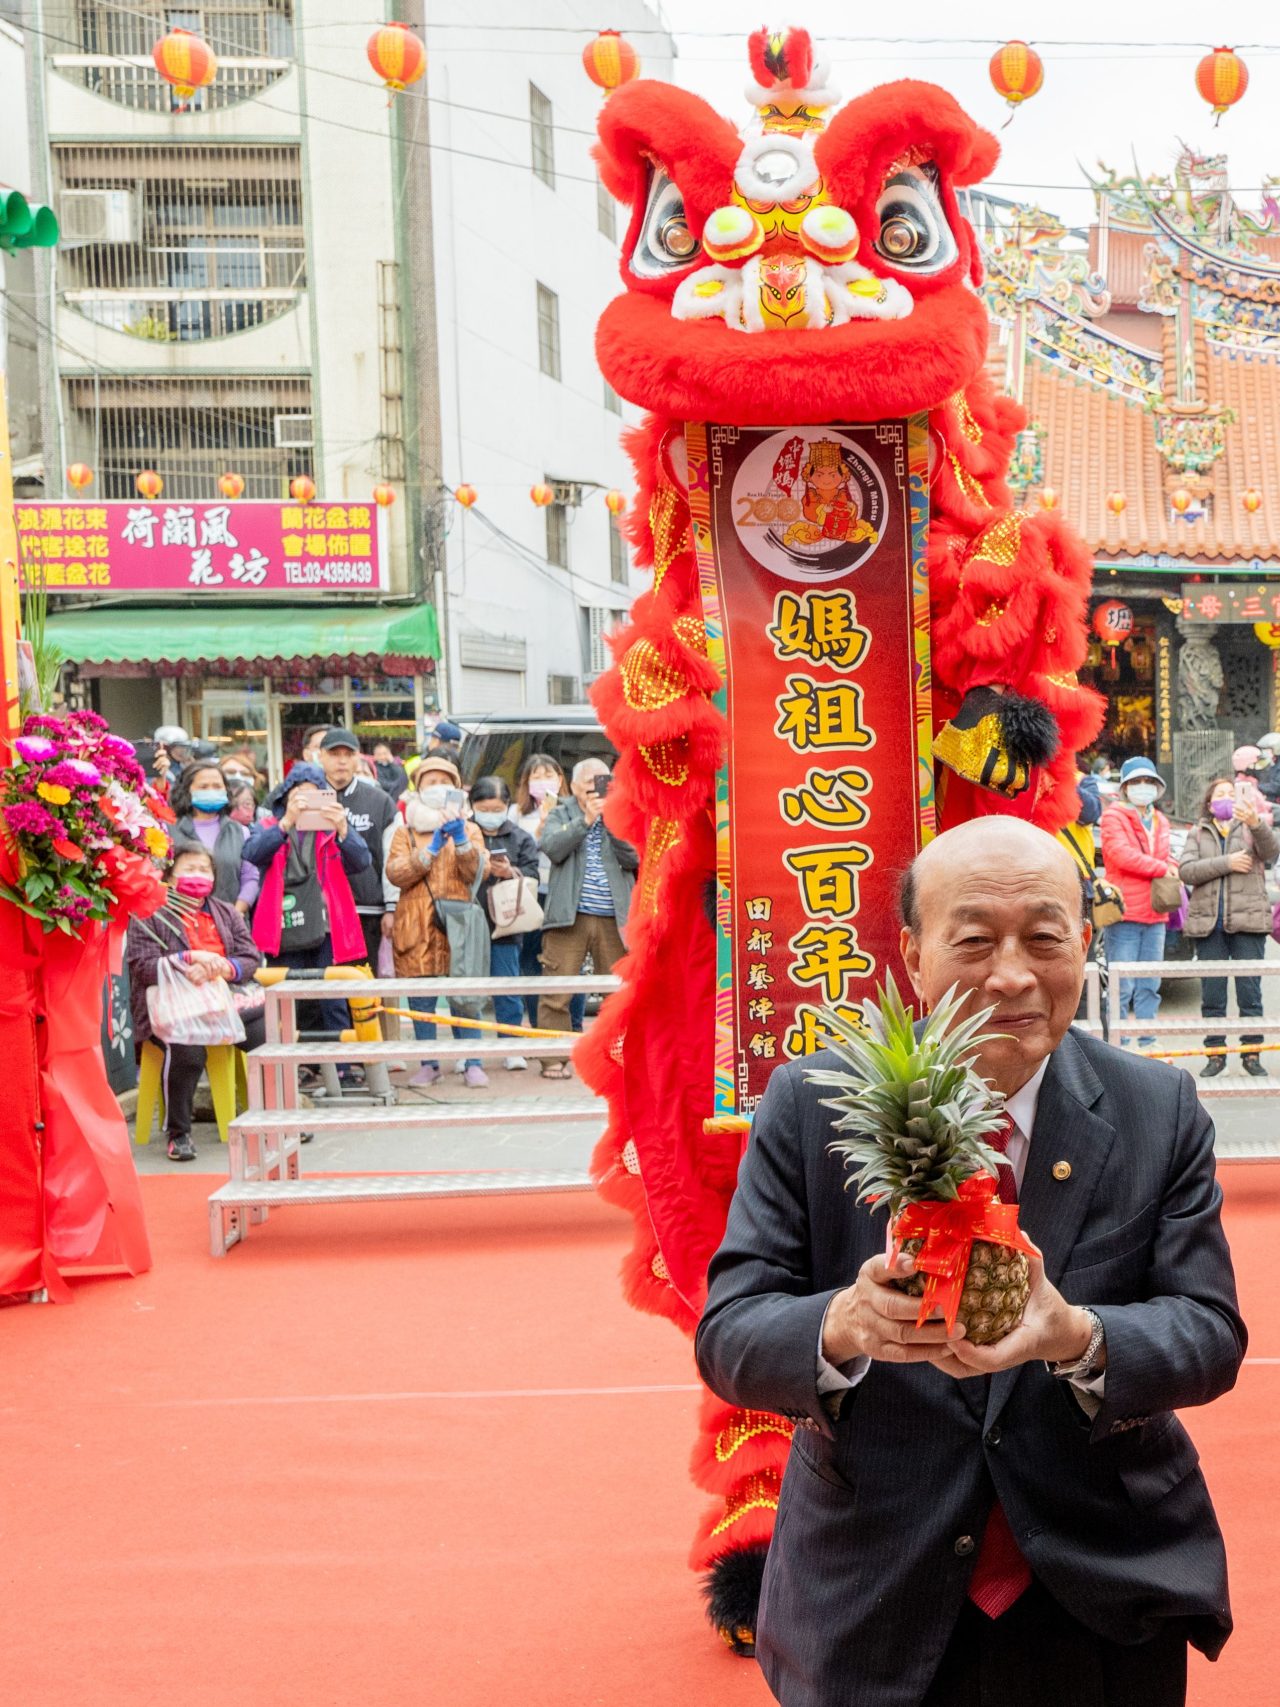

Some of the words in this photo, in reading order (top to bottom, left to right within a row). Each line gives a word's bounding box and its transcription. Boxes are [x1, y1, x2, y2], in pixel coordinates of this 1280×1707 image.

[846, 454, 875, 487] Zhongli
[869, 490, 879, 521] Matsu
[121, 505, 240, 548] 荷蘭風
[281, 506, 371, 529] 蘭花盆栽
[736, 497, 800, 527] 200
[188, 547, 270, 585] 花坊
[744, 896, 778, 1059] 田都藝陣館
